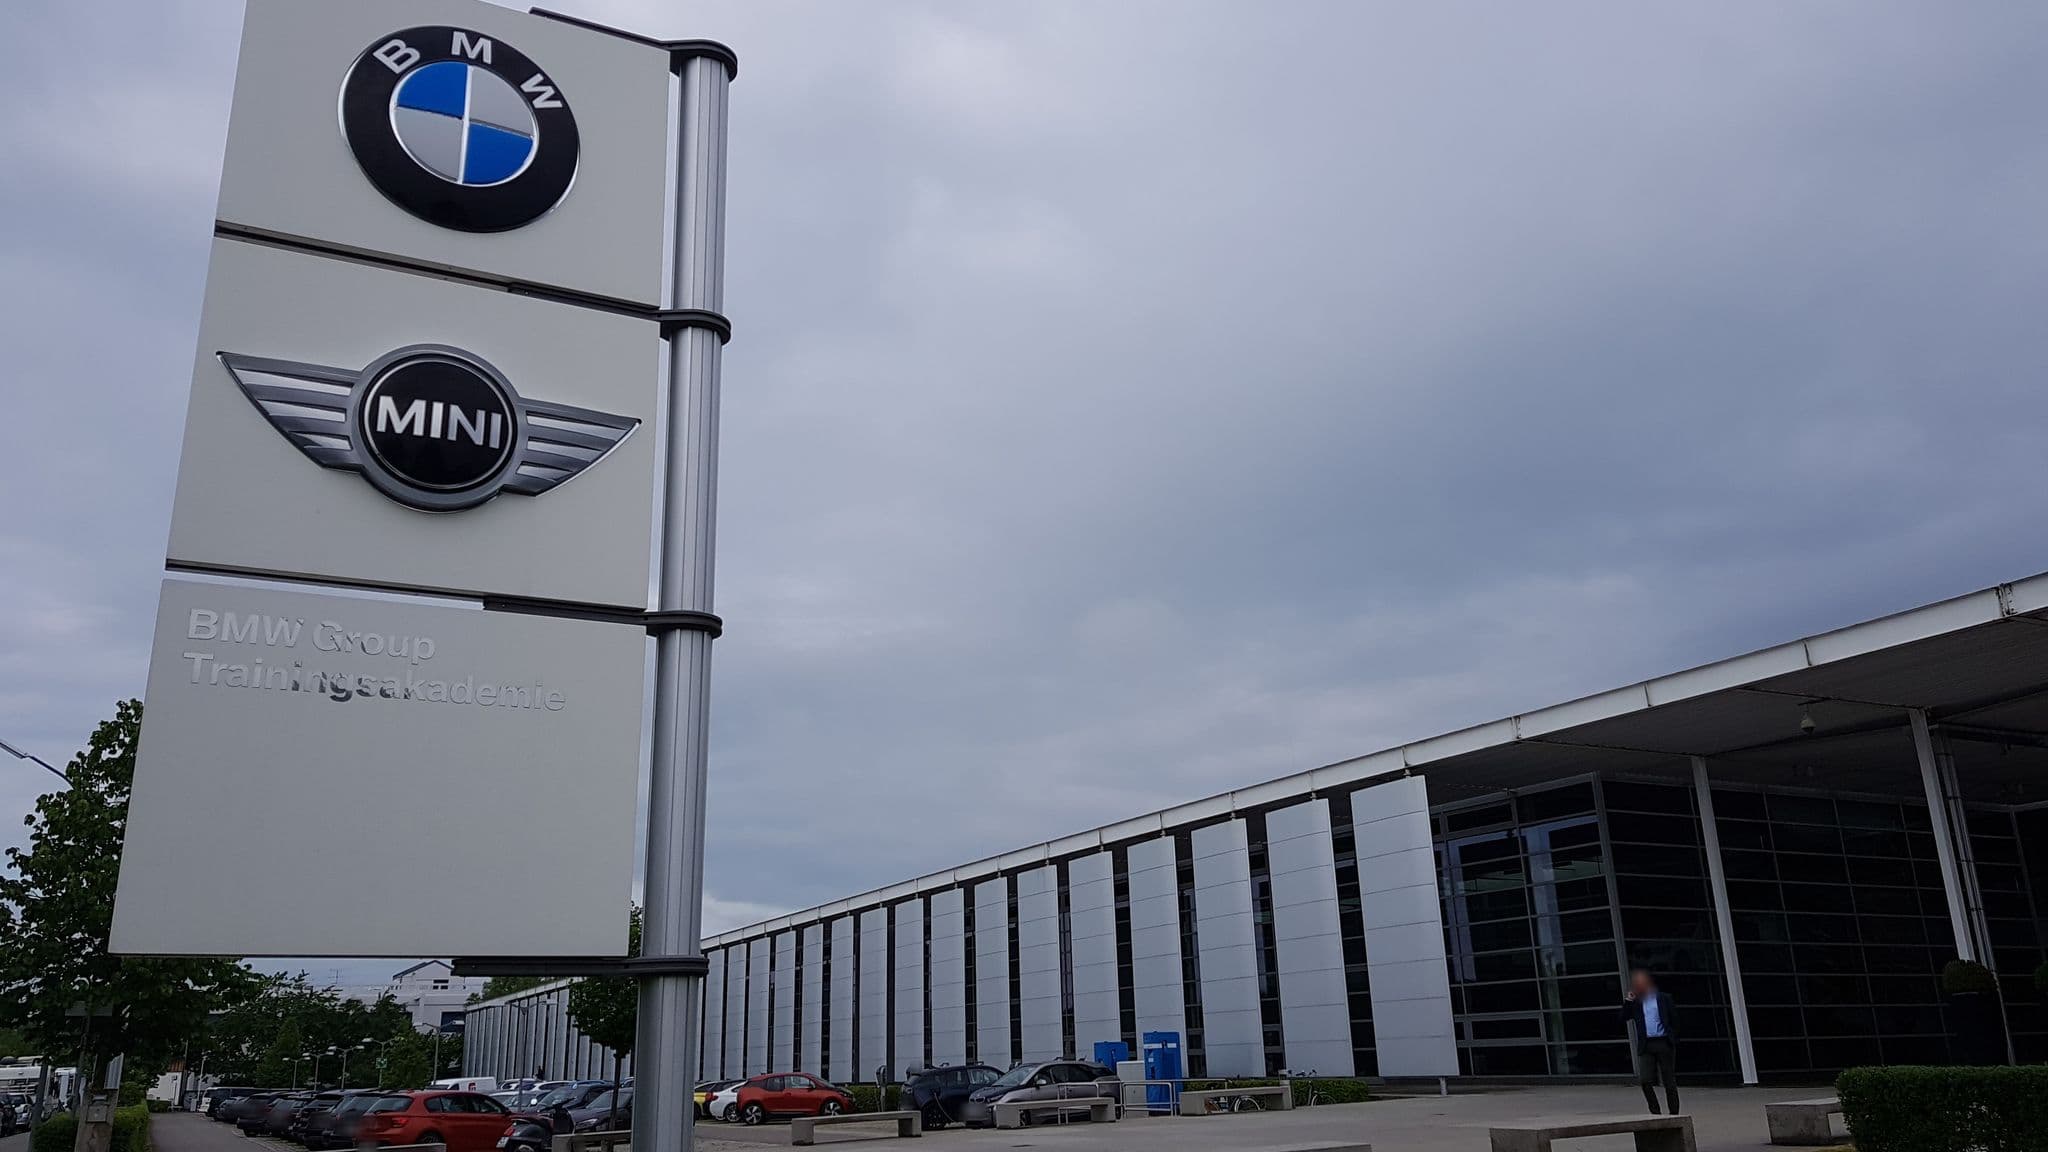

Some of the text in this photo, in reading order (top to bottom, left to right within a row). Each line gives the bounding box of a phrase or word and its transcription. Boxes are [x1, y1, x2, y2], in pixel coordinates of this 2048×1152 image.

[373, 31, 563, 111] BMW
[375, 395, 503, 449] MINI
[186, 608, 436, 665] BMW Group
[183, 651, 568, 712] Trainingsakademie
